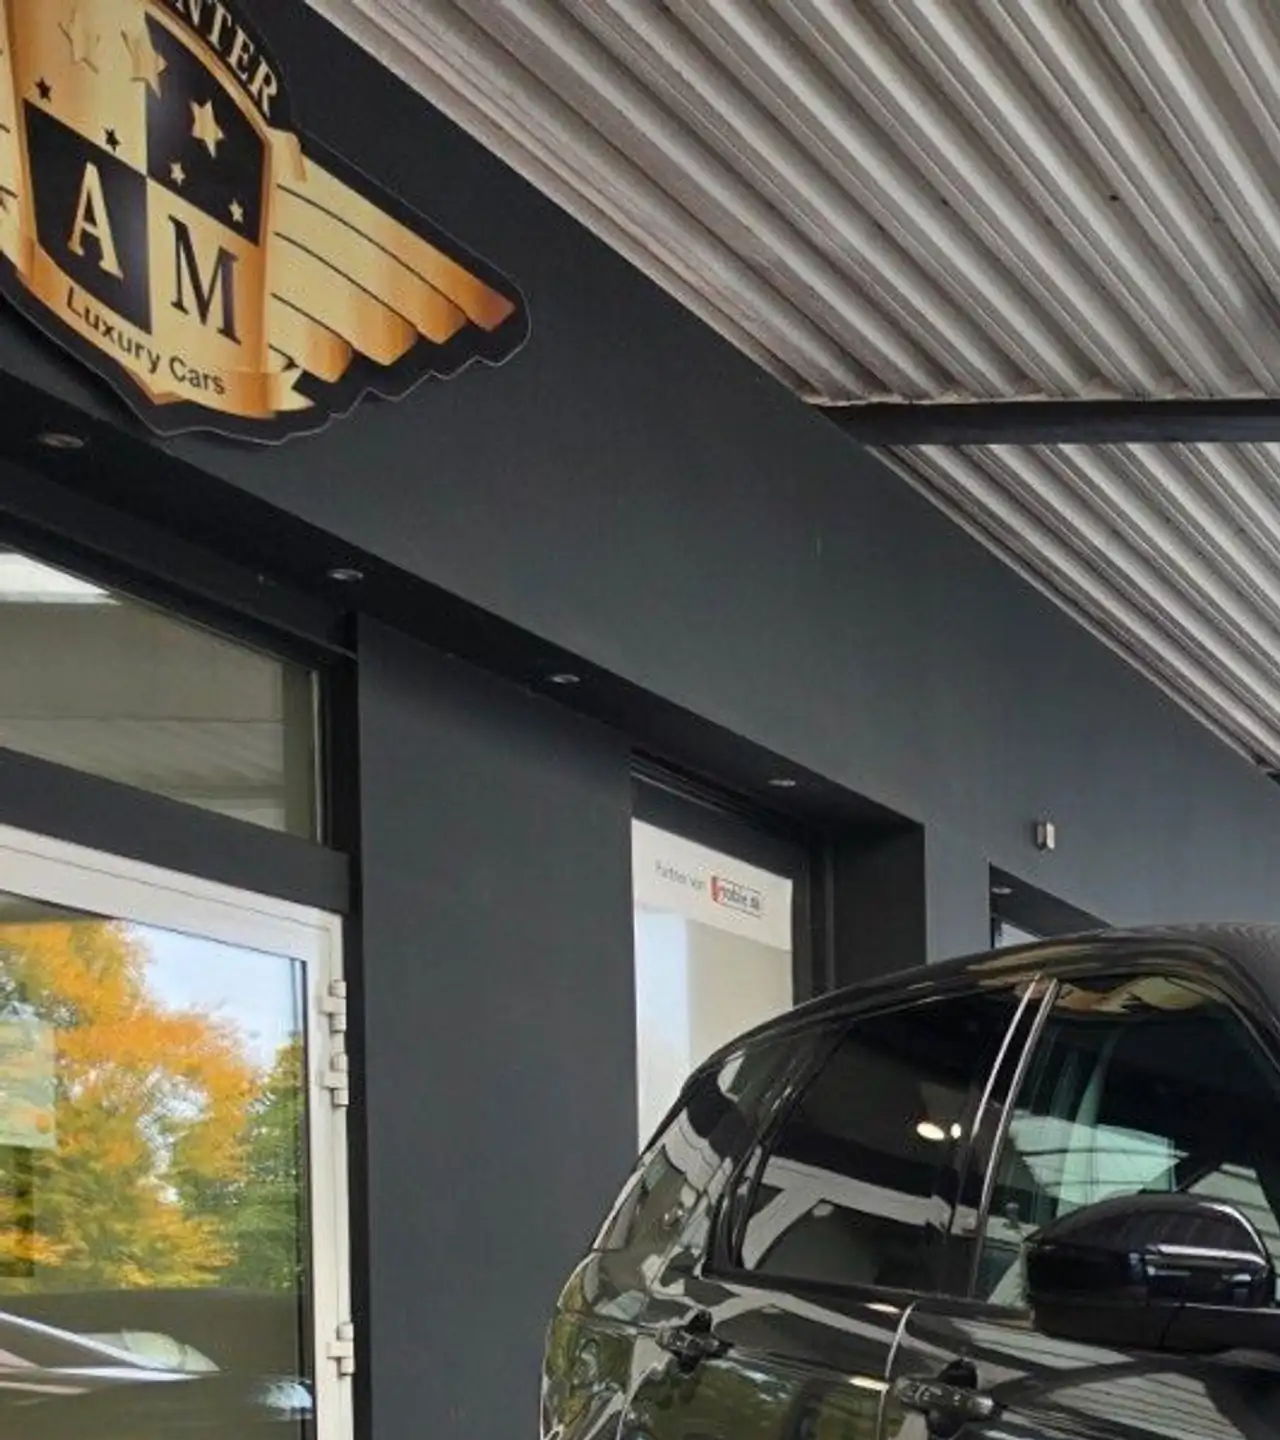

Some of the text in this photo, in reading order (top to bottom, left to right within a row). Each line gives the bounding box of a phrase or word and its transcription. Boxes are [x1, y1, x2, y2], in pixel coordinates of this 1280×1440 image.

[67, 160, 242, 346] A M
[66, 286, 226, 395] Luxury Cars
